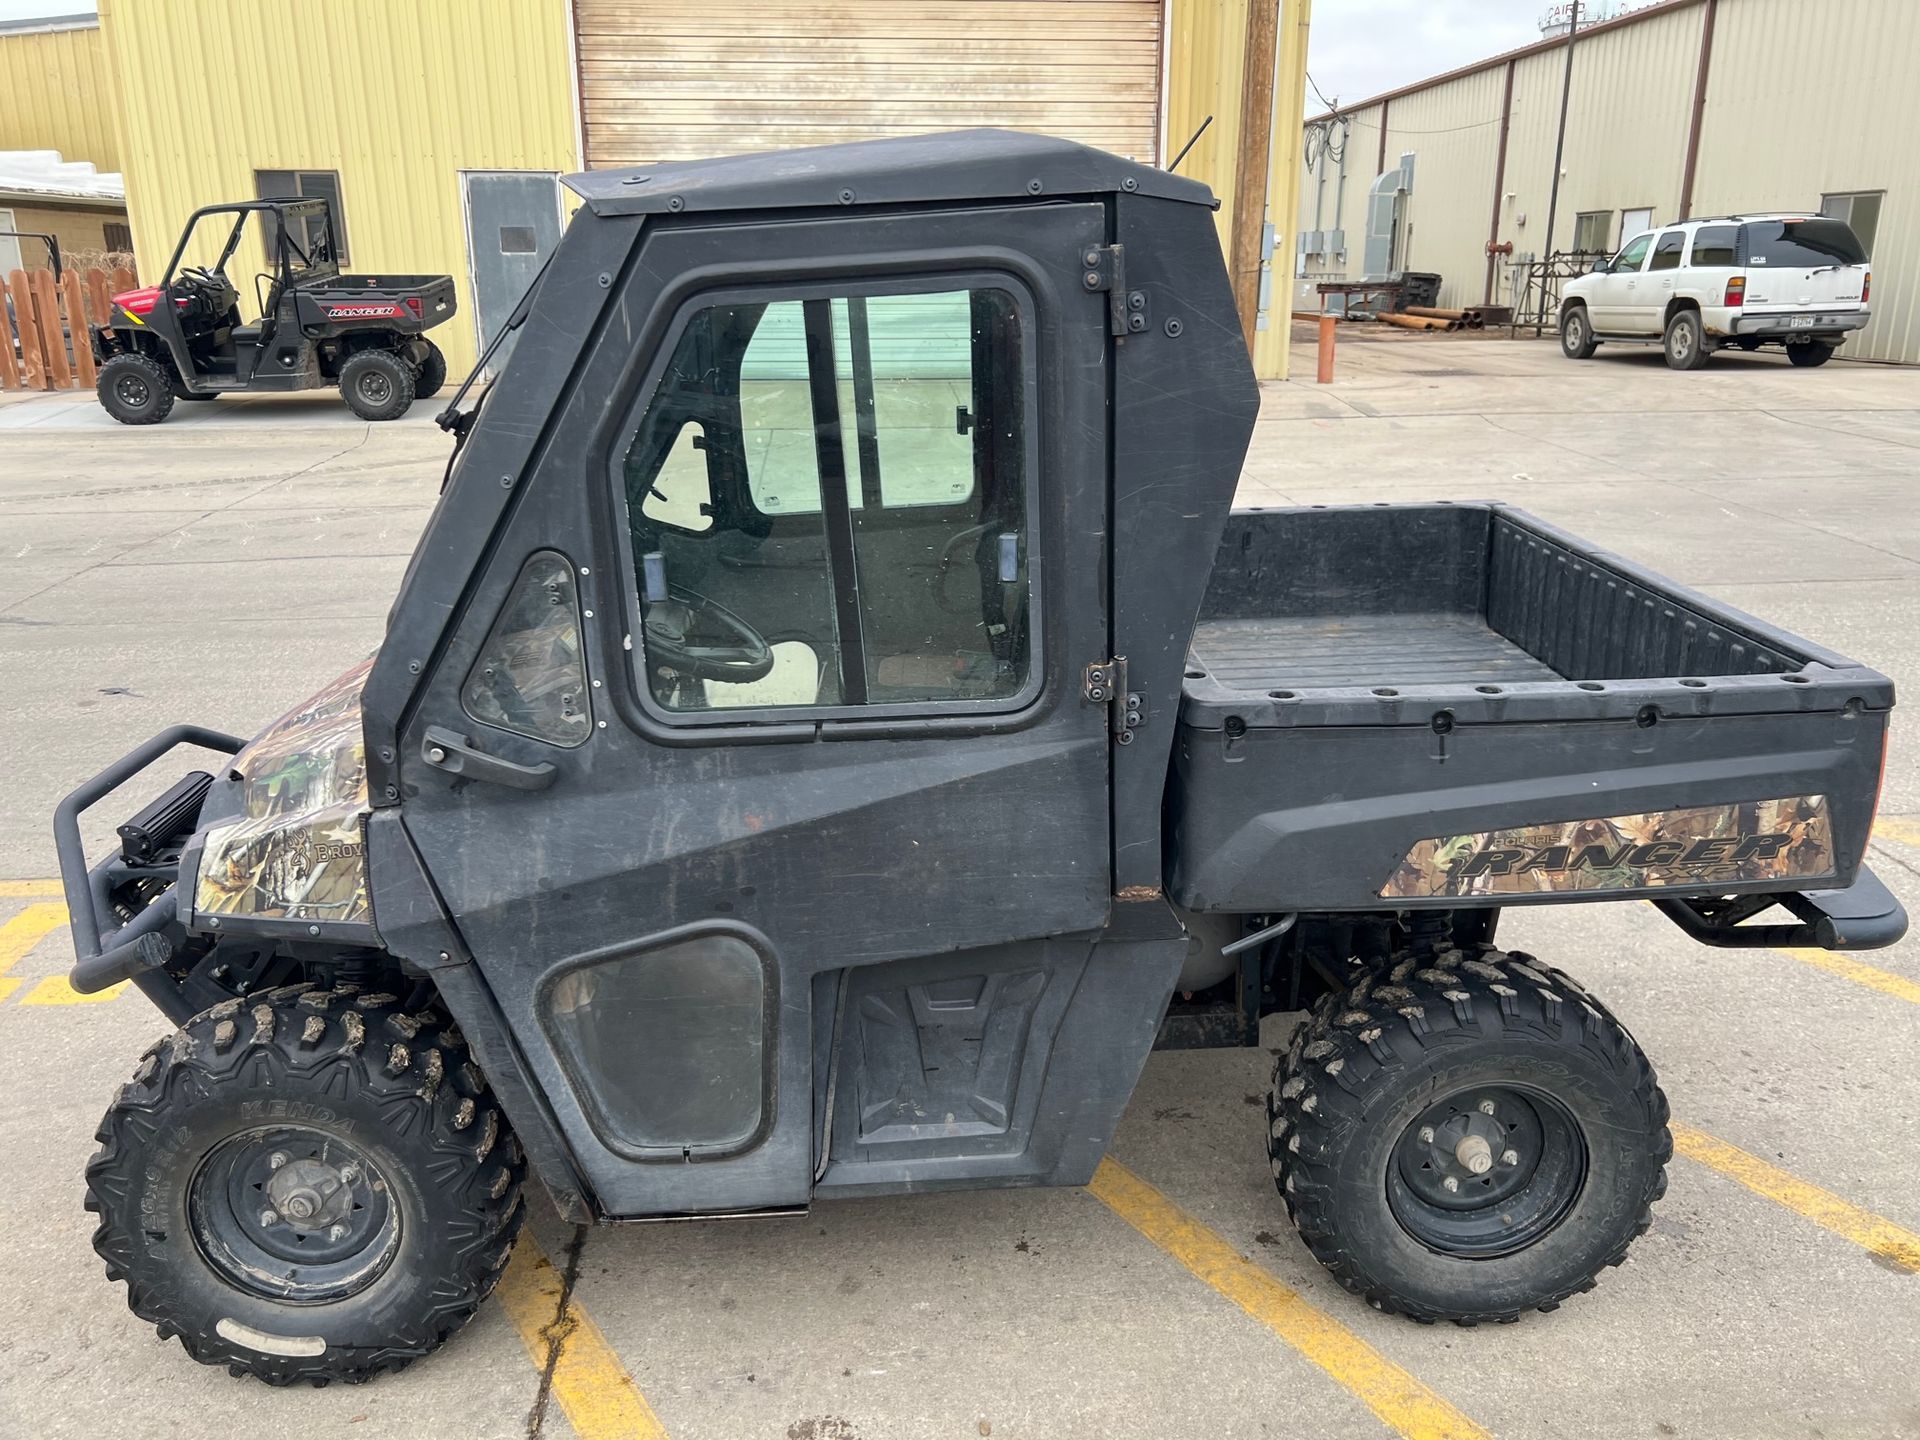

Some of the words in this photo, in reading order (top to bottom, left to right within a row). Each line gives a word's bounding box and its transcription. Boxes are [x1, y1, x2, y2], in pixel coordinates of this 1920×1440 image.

[328, 307, 395, 317] RANGER
[1494, 834, 1560, 847] POLARIS
[1457, 832, 1793, 877] RANGER
[1655, 862, 1739, 880] XP
[241, 1099, 357, 1134] KENDA
